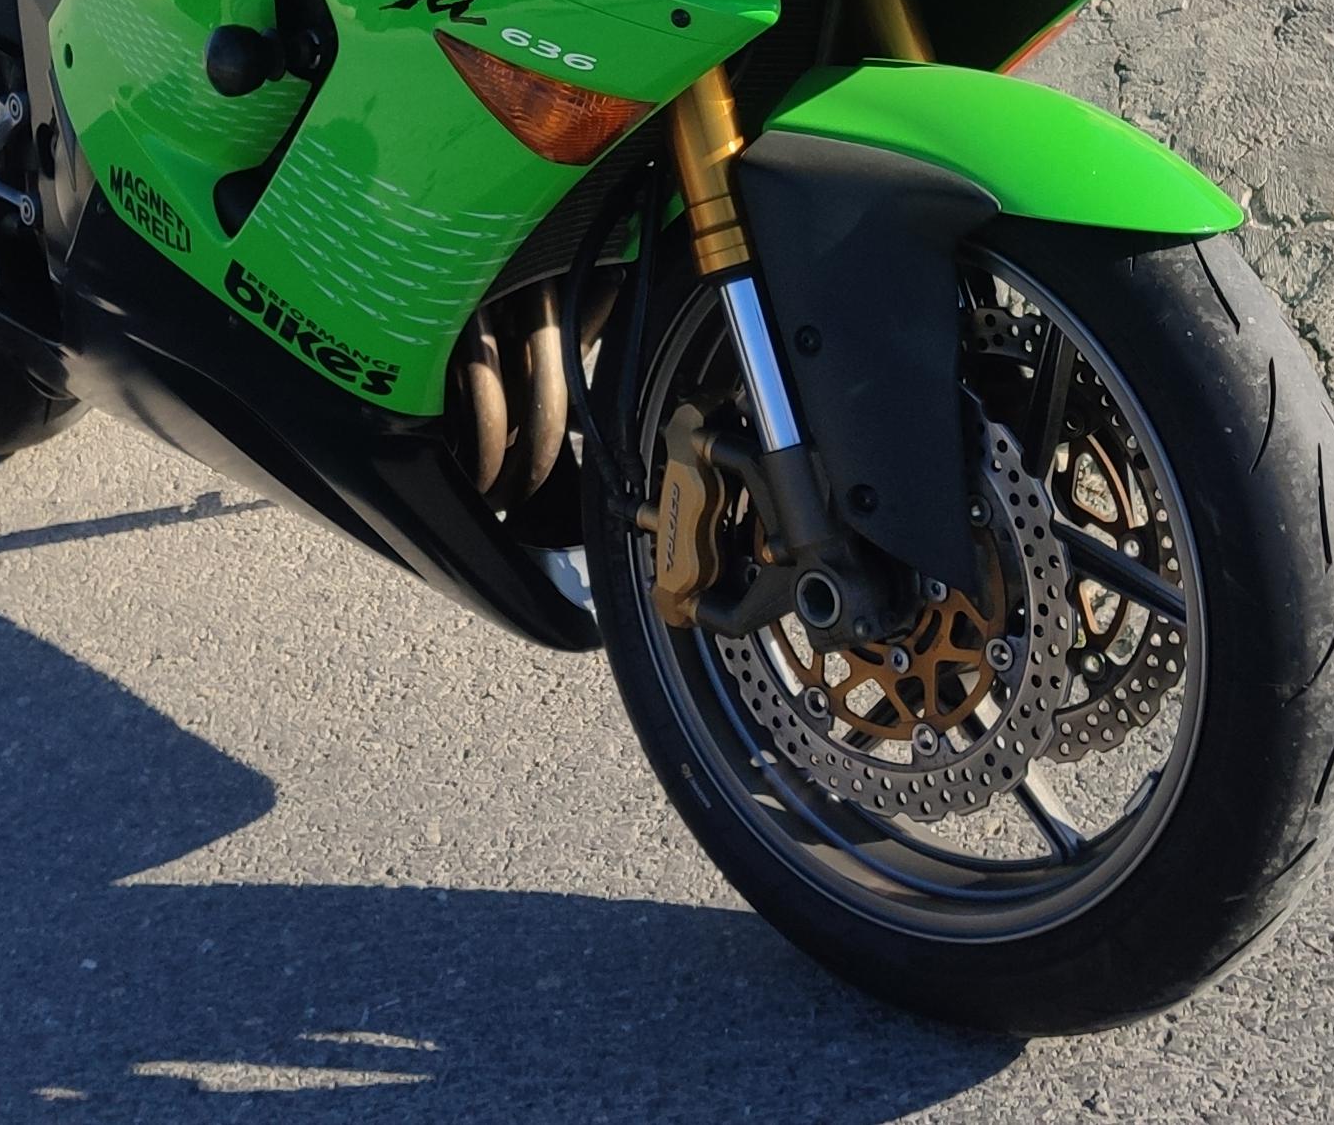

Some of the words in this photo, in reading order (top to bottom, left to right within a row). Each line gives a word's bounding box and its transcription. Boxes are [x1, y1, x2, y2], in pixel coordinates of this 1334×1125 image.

[501, 27, 598, 71] 636
[109, 164, 192, 249] MAGNETI
[246, 272, 402, 374] PERFORMANCE
